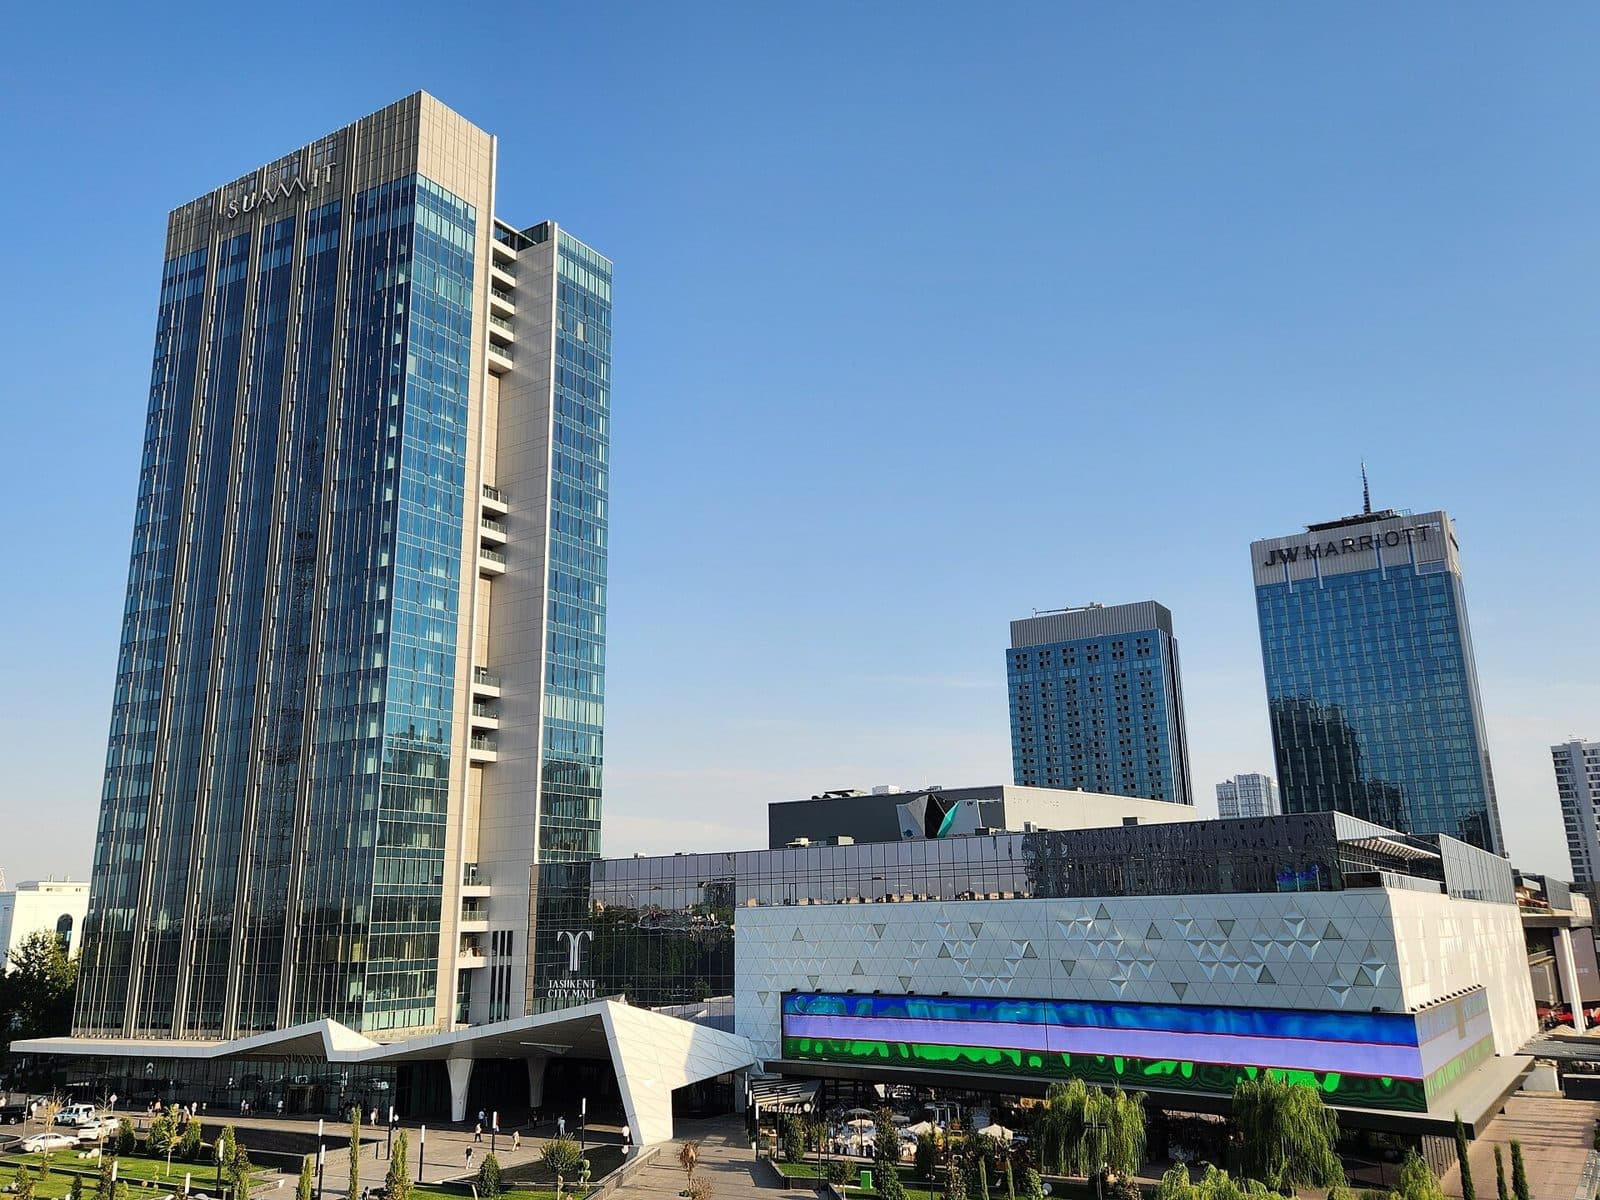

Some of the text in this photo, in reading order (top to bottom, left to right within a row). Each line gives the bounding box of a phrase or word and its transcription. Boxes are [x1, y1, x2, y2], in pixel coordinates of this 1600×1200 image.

[227, 162, 337, 219] SUMMIT
[1264, 525, 1430, 567] JW MARRIOTT
[547, 989, 596, 999] CITY MALL
[548, 979, 597, 989] TASHKENT
